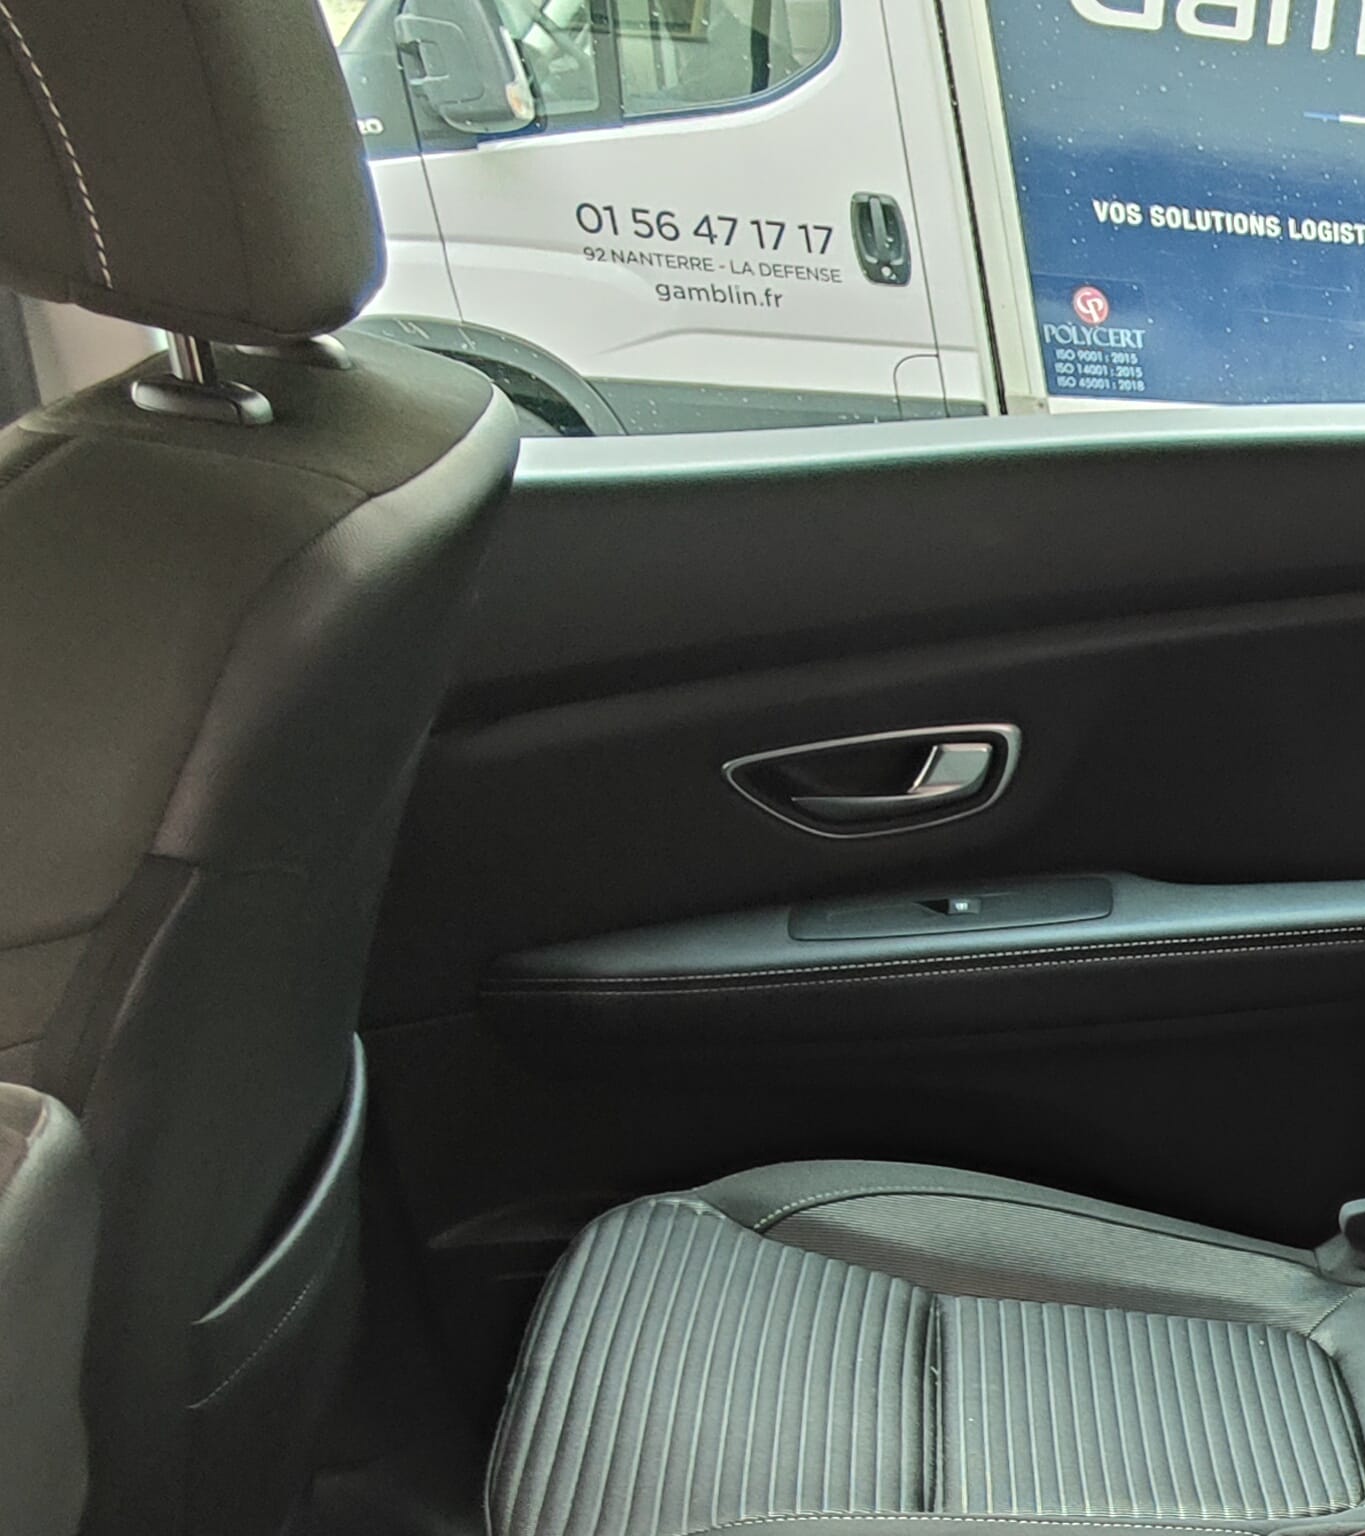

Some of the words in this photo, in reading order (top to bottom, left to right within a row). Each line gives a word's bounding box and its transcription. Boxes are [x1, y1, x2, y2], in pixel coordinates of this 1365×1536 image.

[576, 202, 619, 236] 01
[631, 207, 680, 241] 56
[693, 214, 738, 247] 47
[750, 219, 786, 250] 17
[798, 223, 833, 254] 17
[1091, 199, 1143, 225] VOS
[1149, 204, 1281, 238] SOLUTIONS
[583, 246, 607, 262] 92
[611, 249, 715, 273] NANTERRE
[730, 259, 755, 276] LA
[758, 262, 843, 283] DEFENSE
[655, 283, 783, 308] gamblin.fr
[1043, 323, 1146, 349] POLYCERT
[1055, 348, 1075, 361] ISO
[1077, 349, 1102, 362] 9001
[1111, 351, 1138, 365] 2015
[1055, 362, 1075, 374] ISO
[1077, 363, 1108, 376] 14001
[1115, 365, 1143, 378] 2015
[1056, 375, 1077, 388] ISO
[1079, 376, 1110, 389] 45001
[1118, 379, 1145, 392] 2018
